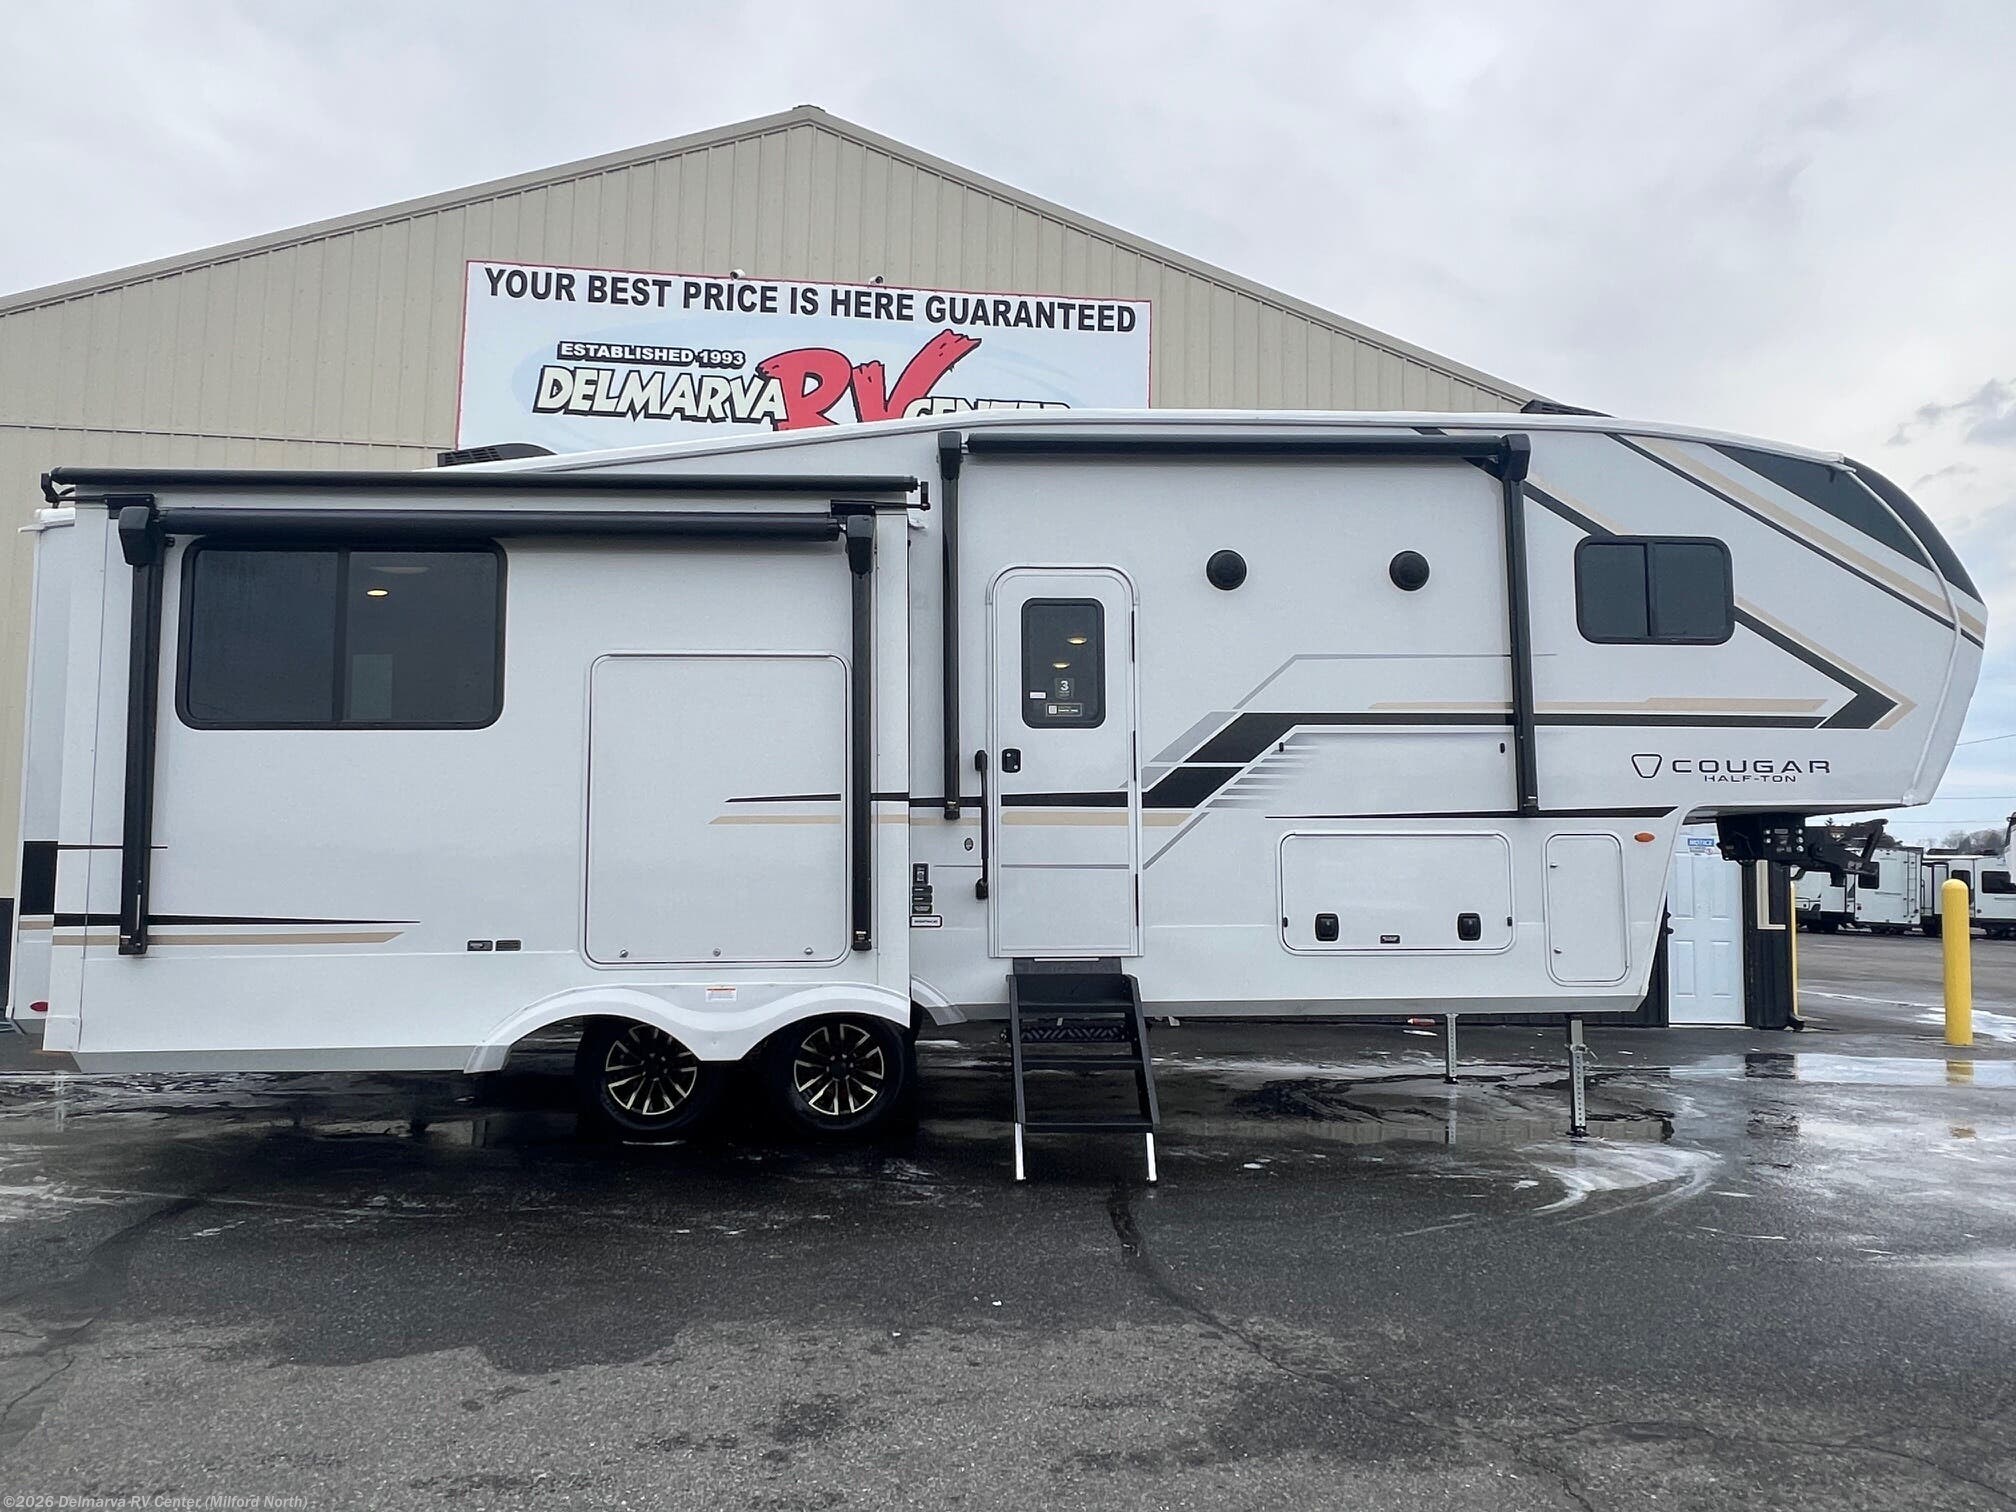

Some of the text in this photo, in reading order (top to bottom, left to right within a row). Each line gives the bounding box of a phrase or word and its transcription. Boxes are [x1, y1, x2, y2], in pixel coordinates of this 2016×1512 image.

[484, 267, 1136, 332] YOUR BEST PRICE IS HERE GUARANTEED
[558, 341, 746, 368] ESTABLISHED 1993
[533, 329, 982, 430] DELMARVA RV
[1671, 760, 1831, 774] COUGAR
[1704, 775, 1797, 783] HALF-TON
